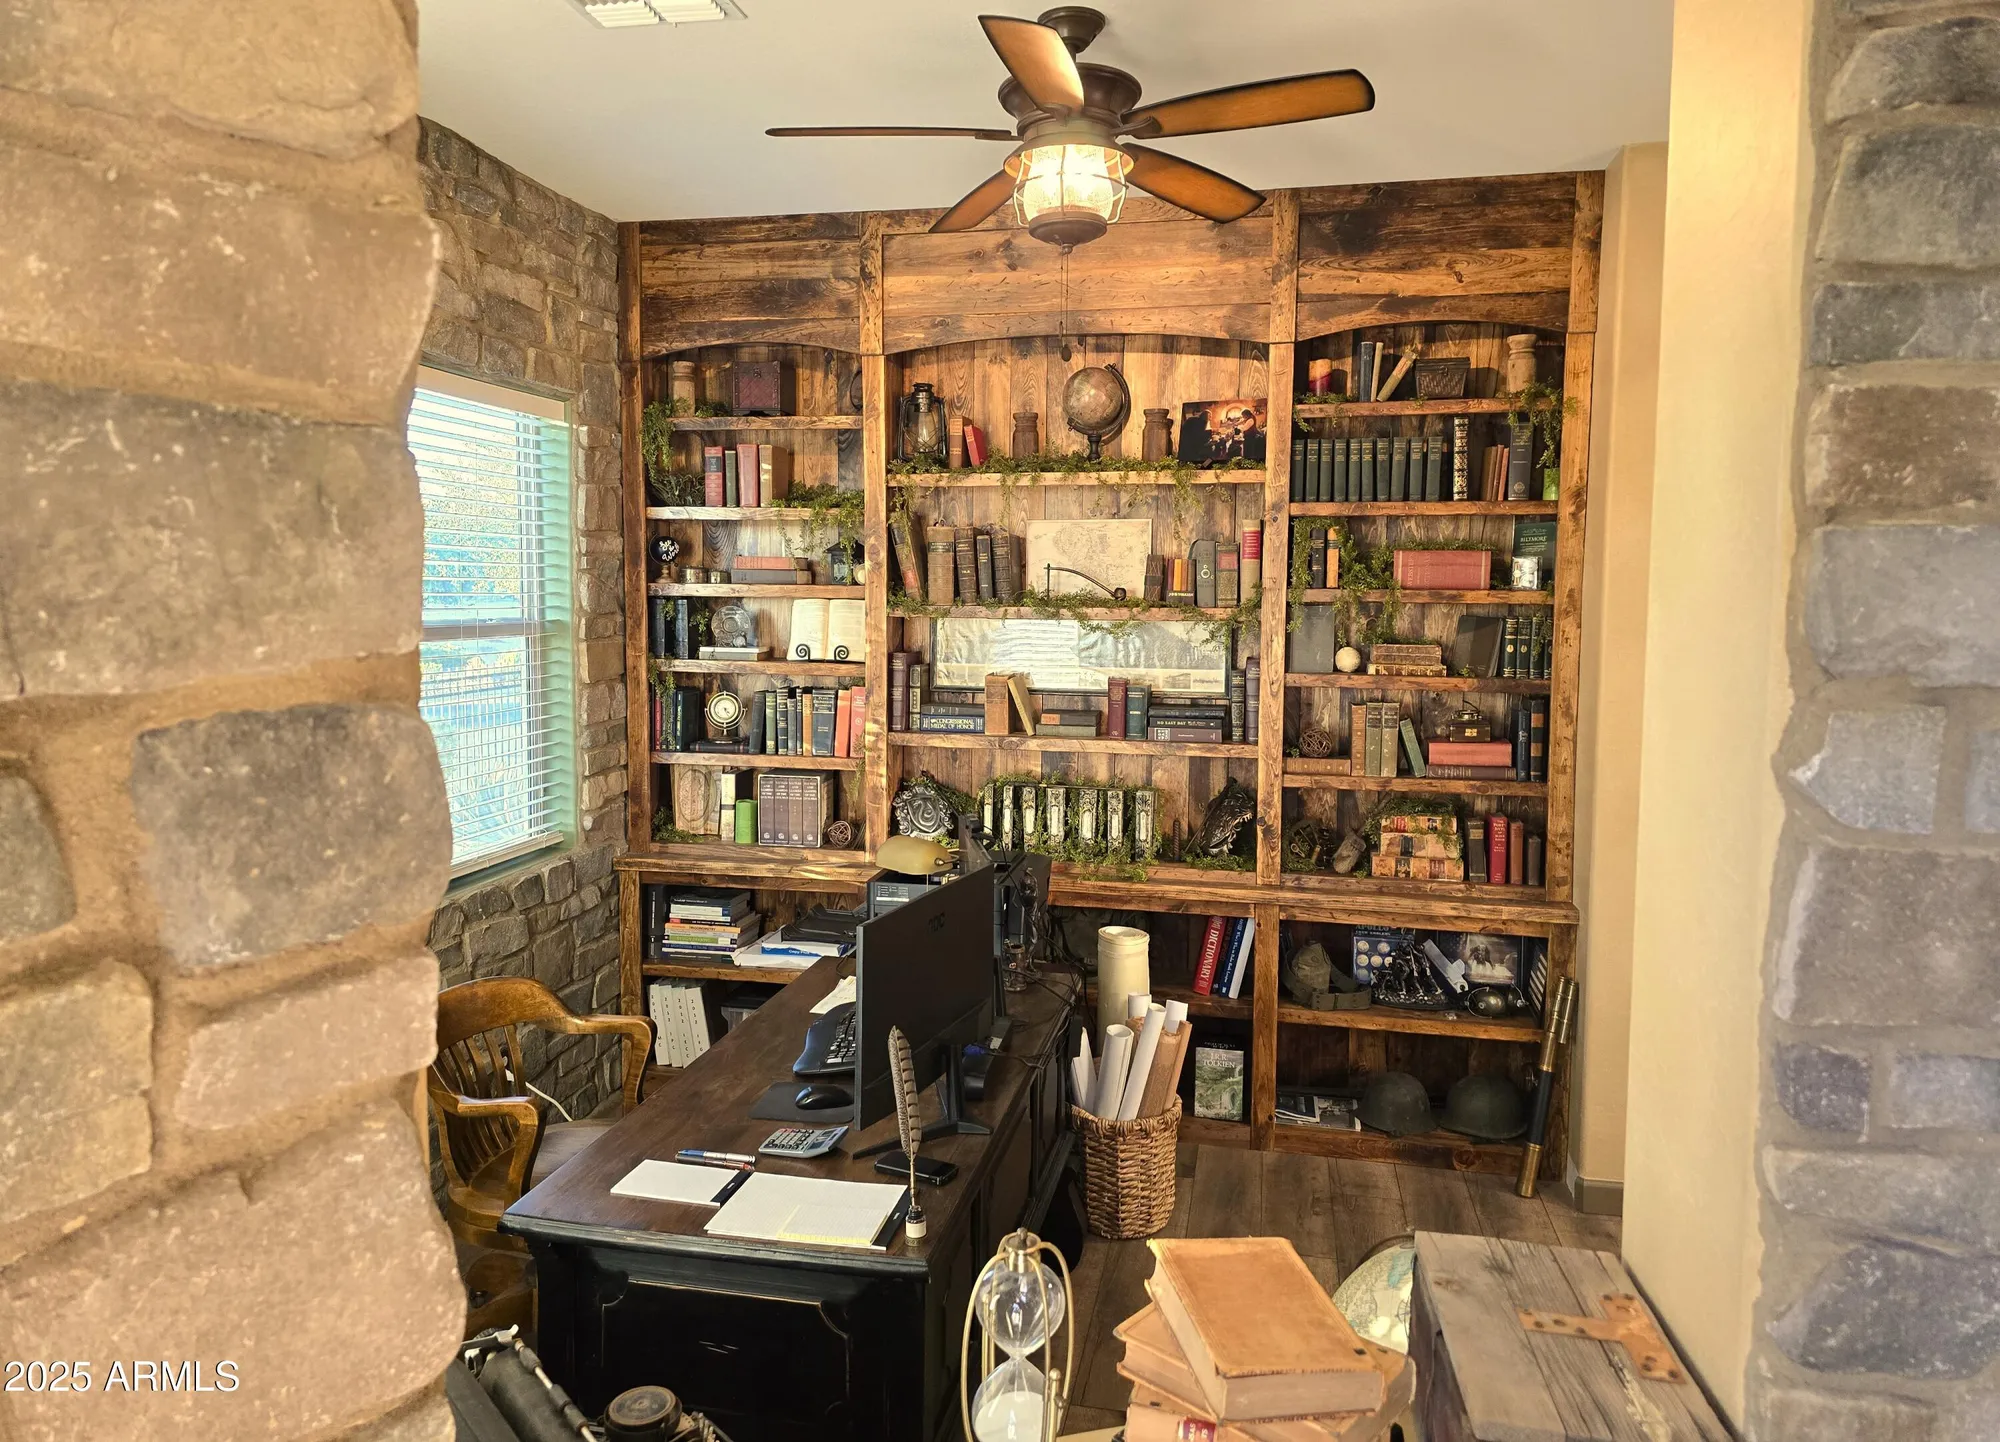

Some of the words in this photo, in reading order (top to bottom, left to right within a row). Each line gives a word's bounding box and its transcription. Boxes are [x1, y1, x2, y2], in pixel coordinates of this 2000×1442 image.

[1520, 535, 1548, 543] BILTMORE
[1200, 929, 1219, 981] DICTIONARY
[1203, 1060, 1236, 1068] TOLKIEN
